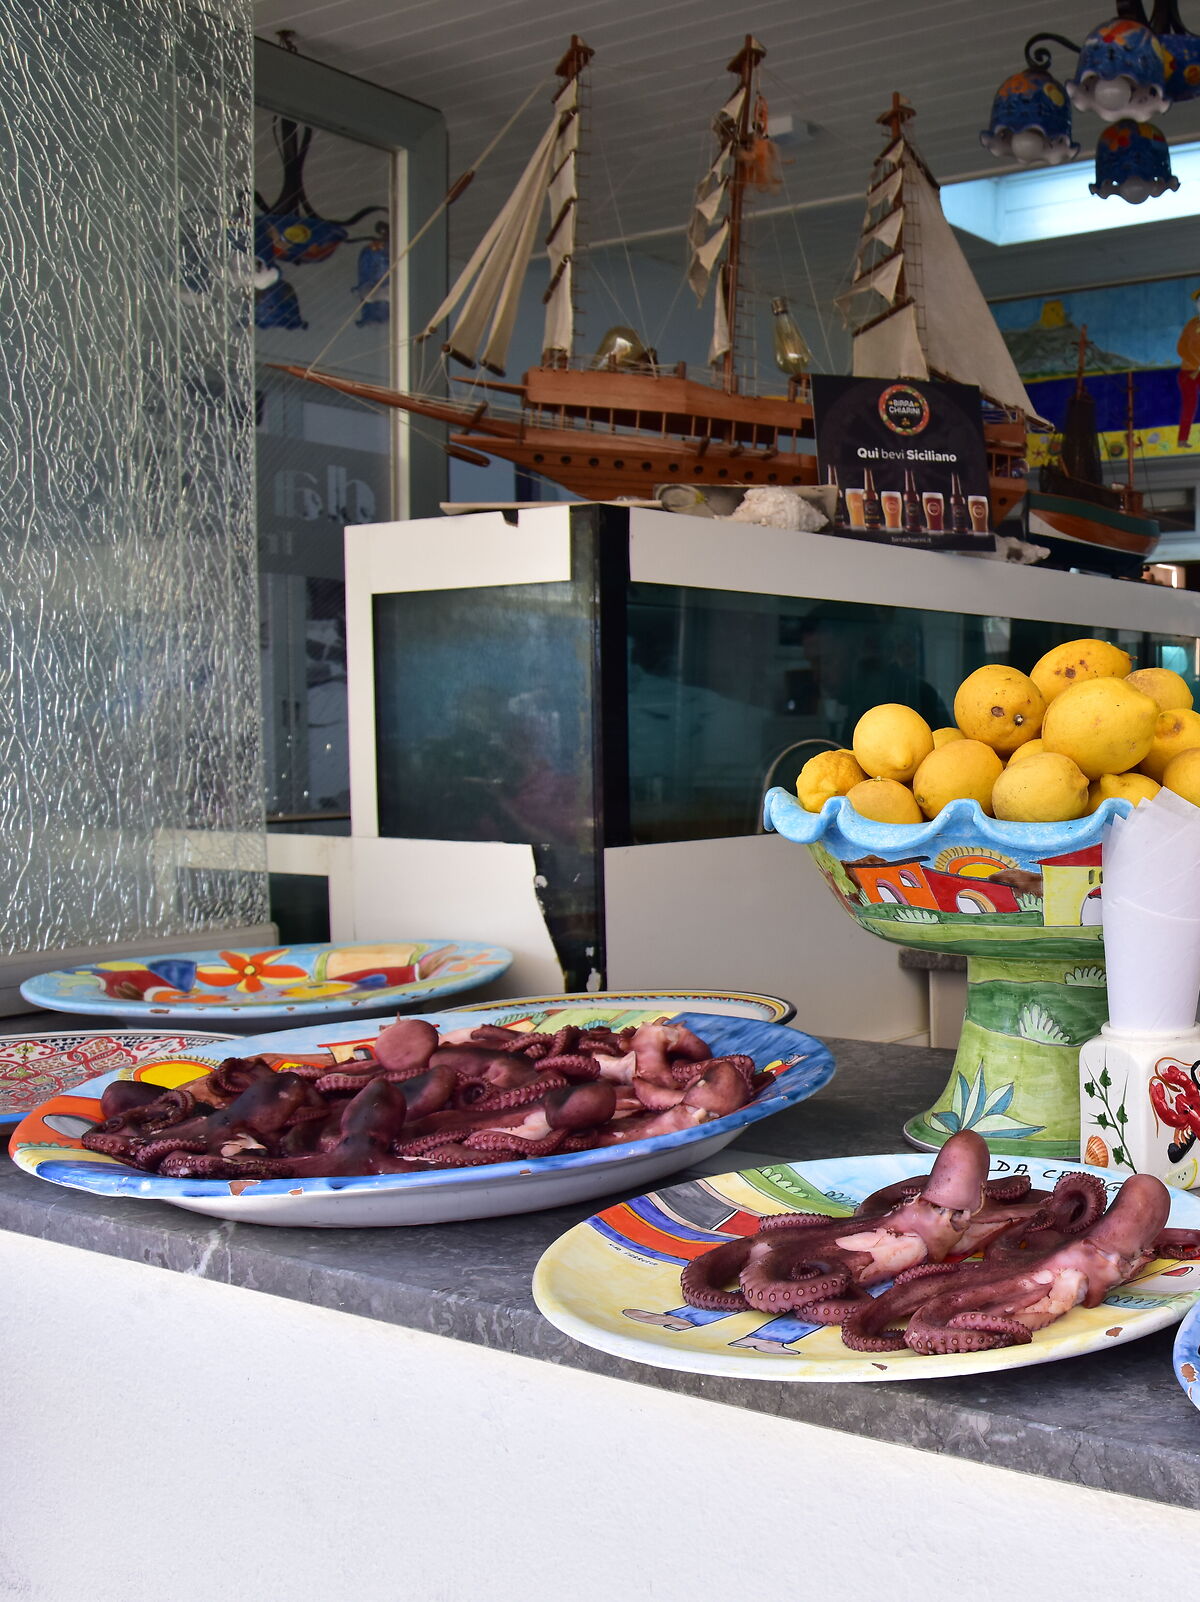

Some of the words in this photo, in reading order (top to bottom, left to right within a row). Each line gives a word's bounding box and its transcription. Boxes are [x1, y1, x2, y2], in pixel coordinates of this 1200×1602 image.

[888, 406, 921, 415] CHIARINI
[857, 447, 879, 459] Qui
[881, 449, 905, 460] bevi
[906, 450, 957, 462] Siciliano
[989, 1160, 1029, 1174] DA
